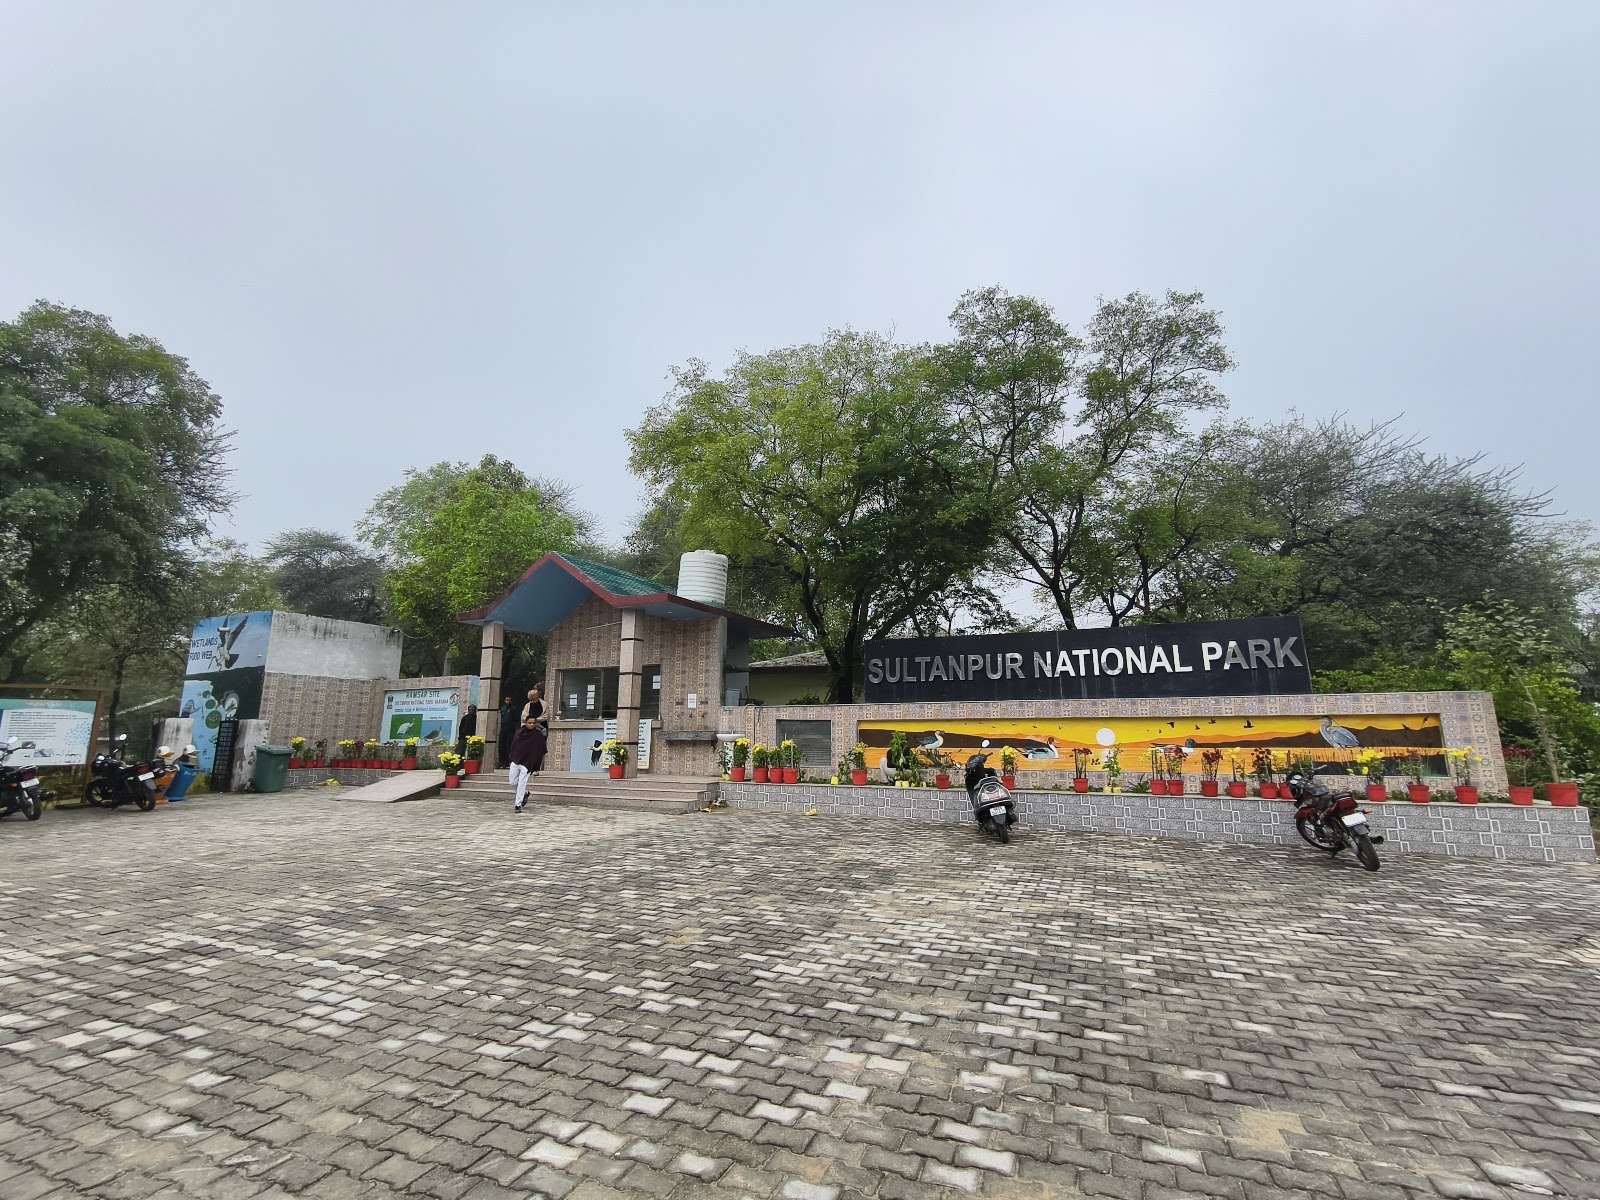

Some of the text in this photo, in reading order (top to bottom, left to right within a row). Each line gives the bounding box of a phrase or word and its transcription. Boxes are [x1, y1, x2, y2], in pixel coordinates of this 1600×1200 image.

[191, 637, 218, 648] WETLANDS
[189, 650, 213, 661] FOOD WEB
[868, 636, 1303, 684] SULTANPUR NATIONAL PARK
